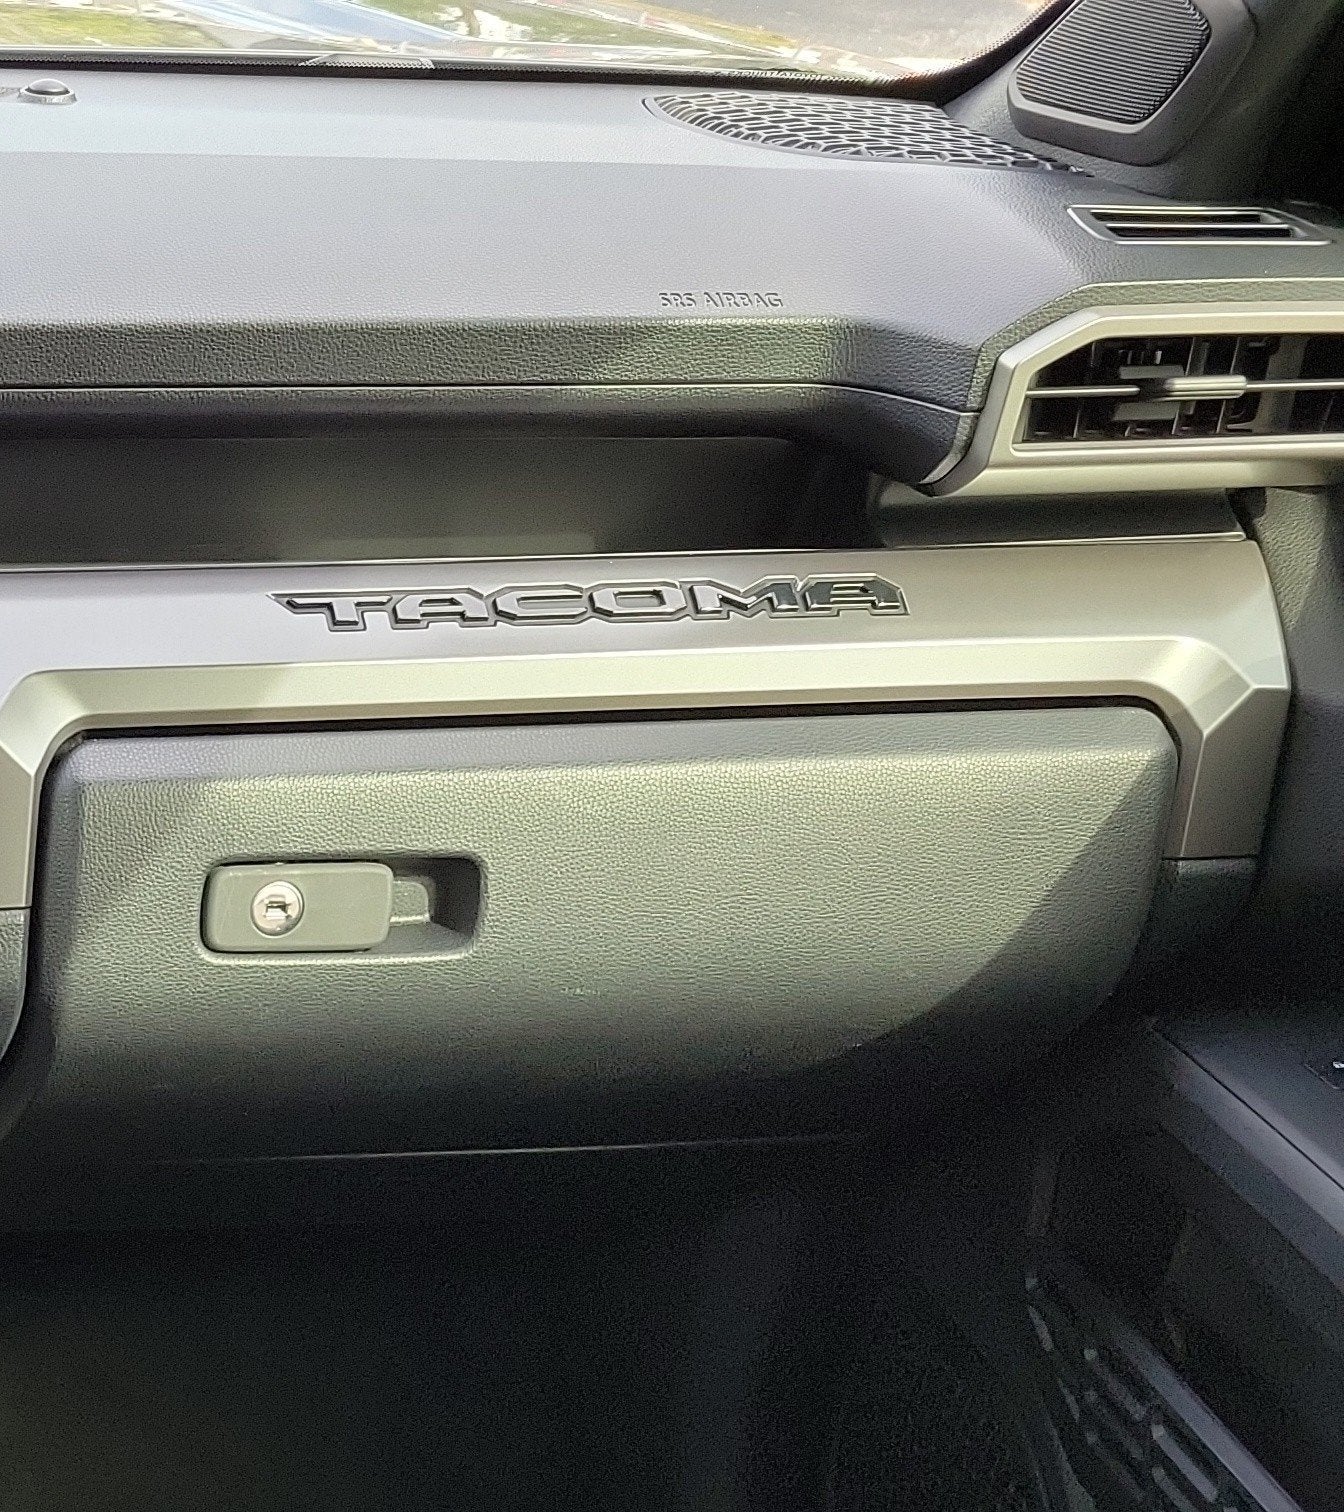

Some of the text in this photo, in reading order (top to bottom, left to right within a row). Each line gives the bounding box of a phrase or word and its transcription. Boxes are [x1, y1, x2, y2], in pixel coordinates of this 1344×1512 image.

[658, 291, 783, 307] SRS AIRBAG
[268, 574, 911, 632] TACOMA
